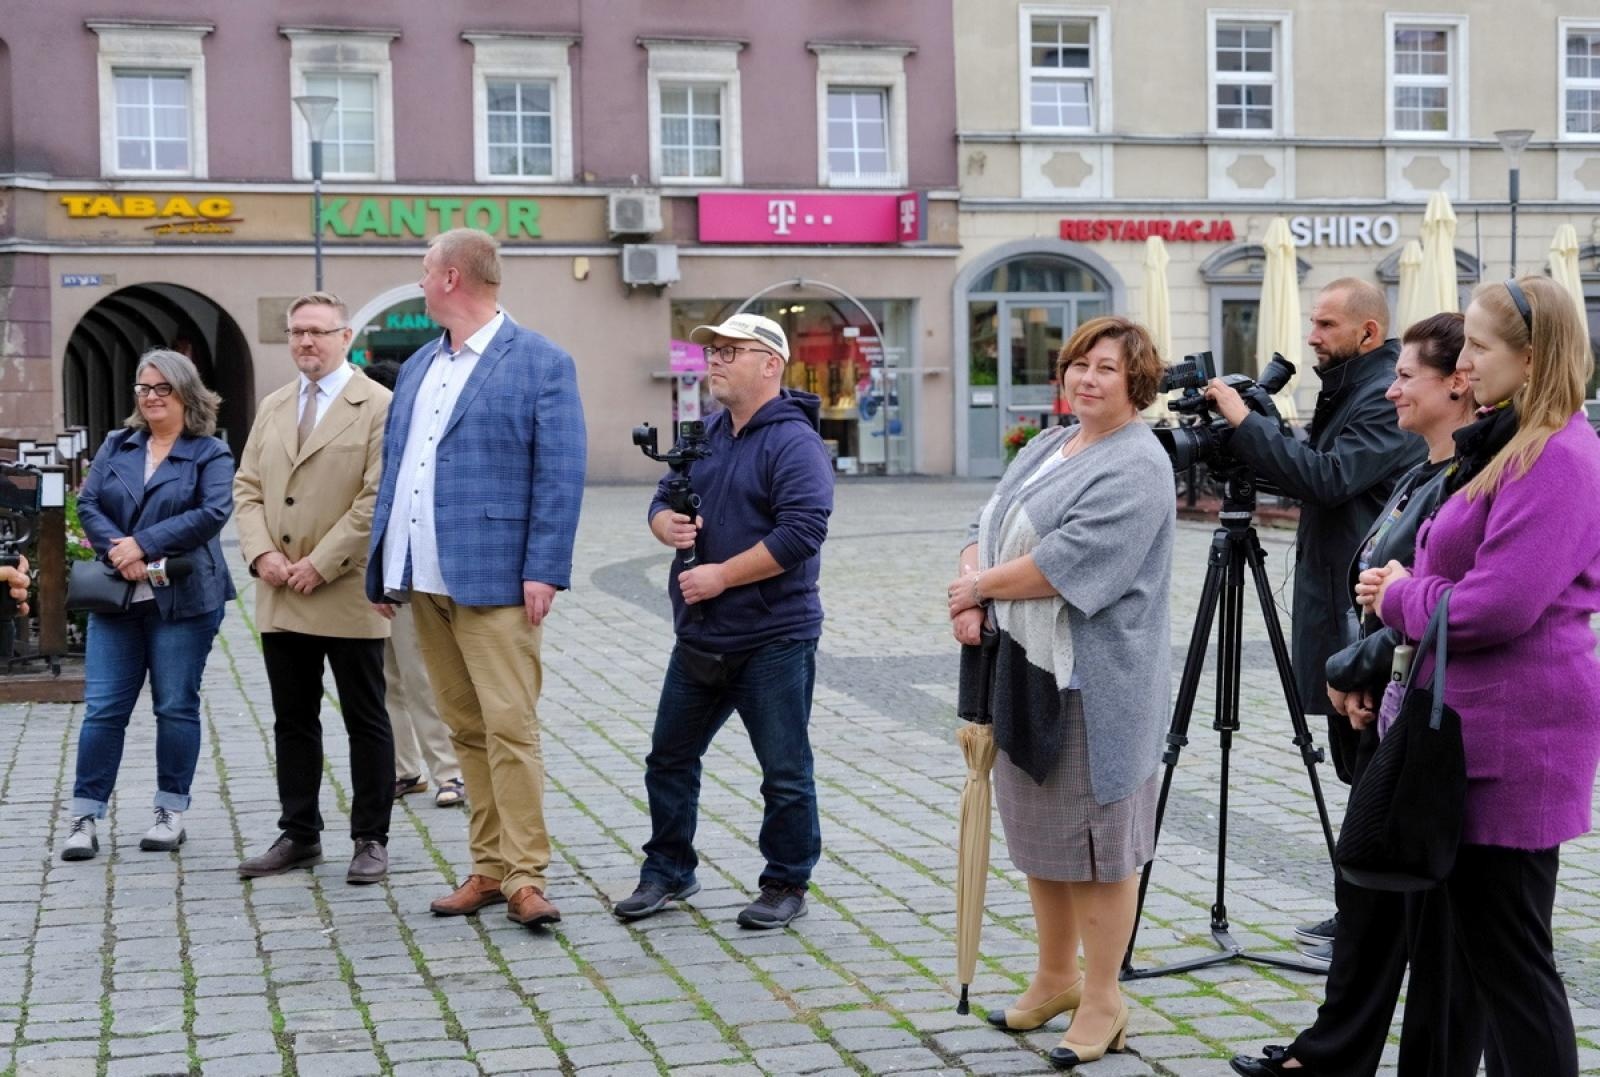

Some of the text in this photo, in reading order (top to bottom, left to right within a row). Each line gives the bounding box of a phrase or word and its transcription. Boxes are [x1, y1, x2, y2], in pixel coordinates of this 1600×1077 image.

[60, 195, 232, 217] TABAC
[312, 196, 541, 237] KANTOR
[1060, 219, 1235, 241] RESTAURACJA
[1290, 215, 1398, 246] SHIRO
